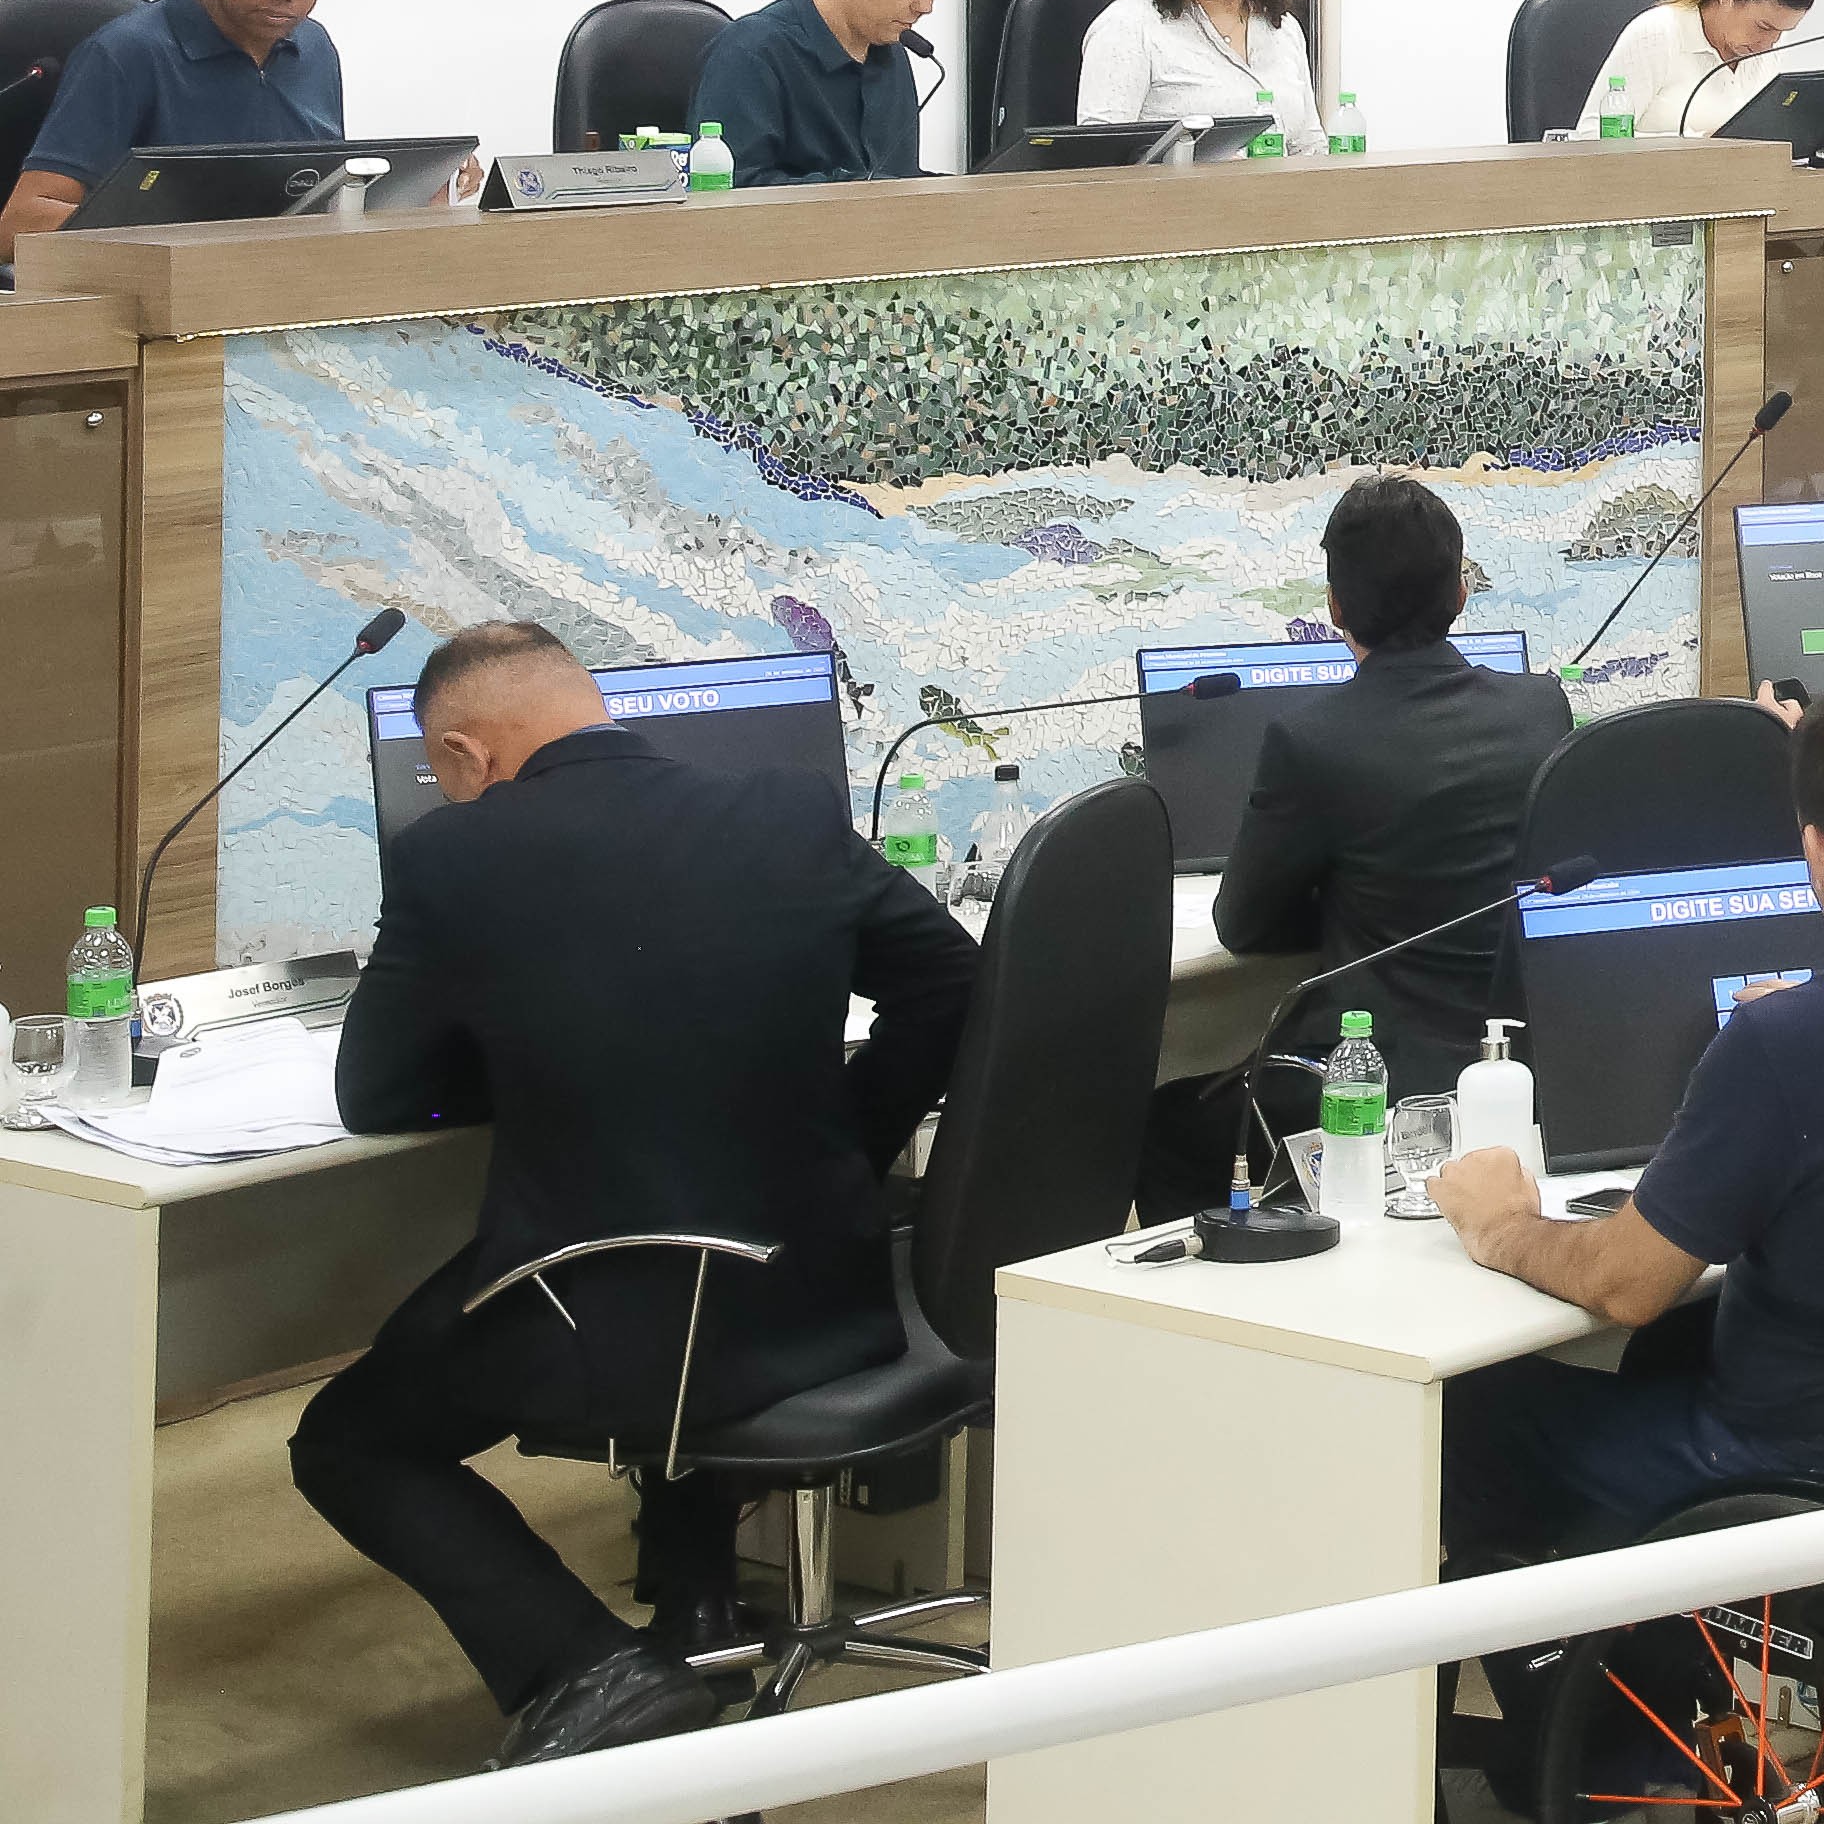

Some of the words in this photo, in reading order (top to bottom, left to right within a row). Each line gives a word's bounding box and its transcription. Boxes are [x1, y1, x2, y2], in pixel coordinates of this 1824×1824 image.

[572, 166, 603, 176] Thiago
[606, 164, 639, 174] Ribeiro
[1250, 666, 1314, 685] DIGITE
[1317, 663, 1354, 682] SUA
[609, 695, 653, 717] SEU
[661, 689, 720, 711] VOTO
[1650, 897, 1724, 922] DIGITE
[1729, 894, 1775, 914] SUA
[1778, 890, 1820, 910] SEN
[228, 986, 260, 1000] Josef
[263, 978, 305, 994] Borges
